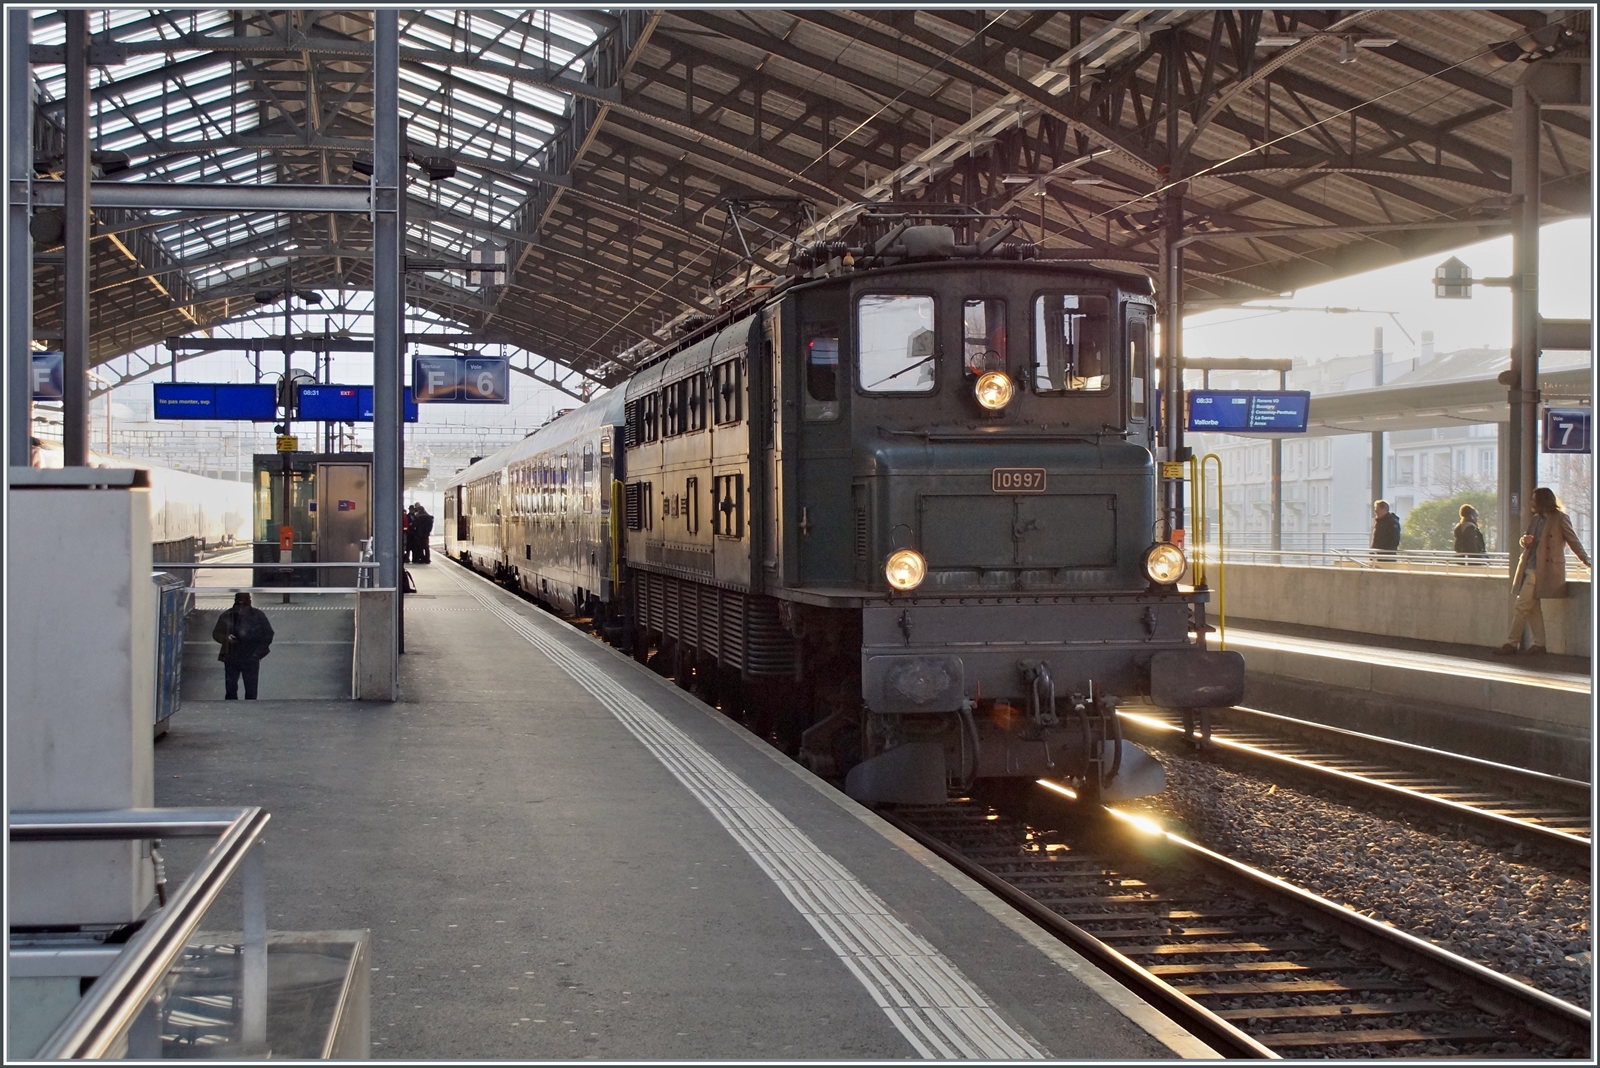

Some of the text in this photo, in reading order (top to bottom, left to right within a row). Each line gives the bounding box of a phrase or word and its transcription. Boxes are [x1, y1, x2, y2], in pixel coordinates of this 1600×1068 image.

[33, 368, 51, 392] F
[428, 371, 445, 395] F
[476, 371, 494, 396] 6
[1559, 423, 1574, 445] 7
[997, 472, 1042, 488] 10997
